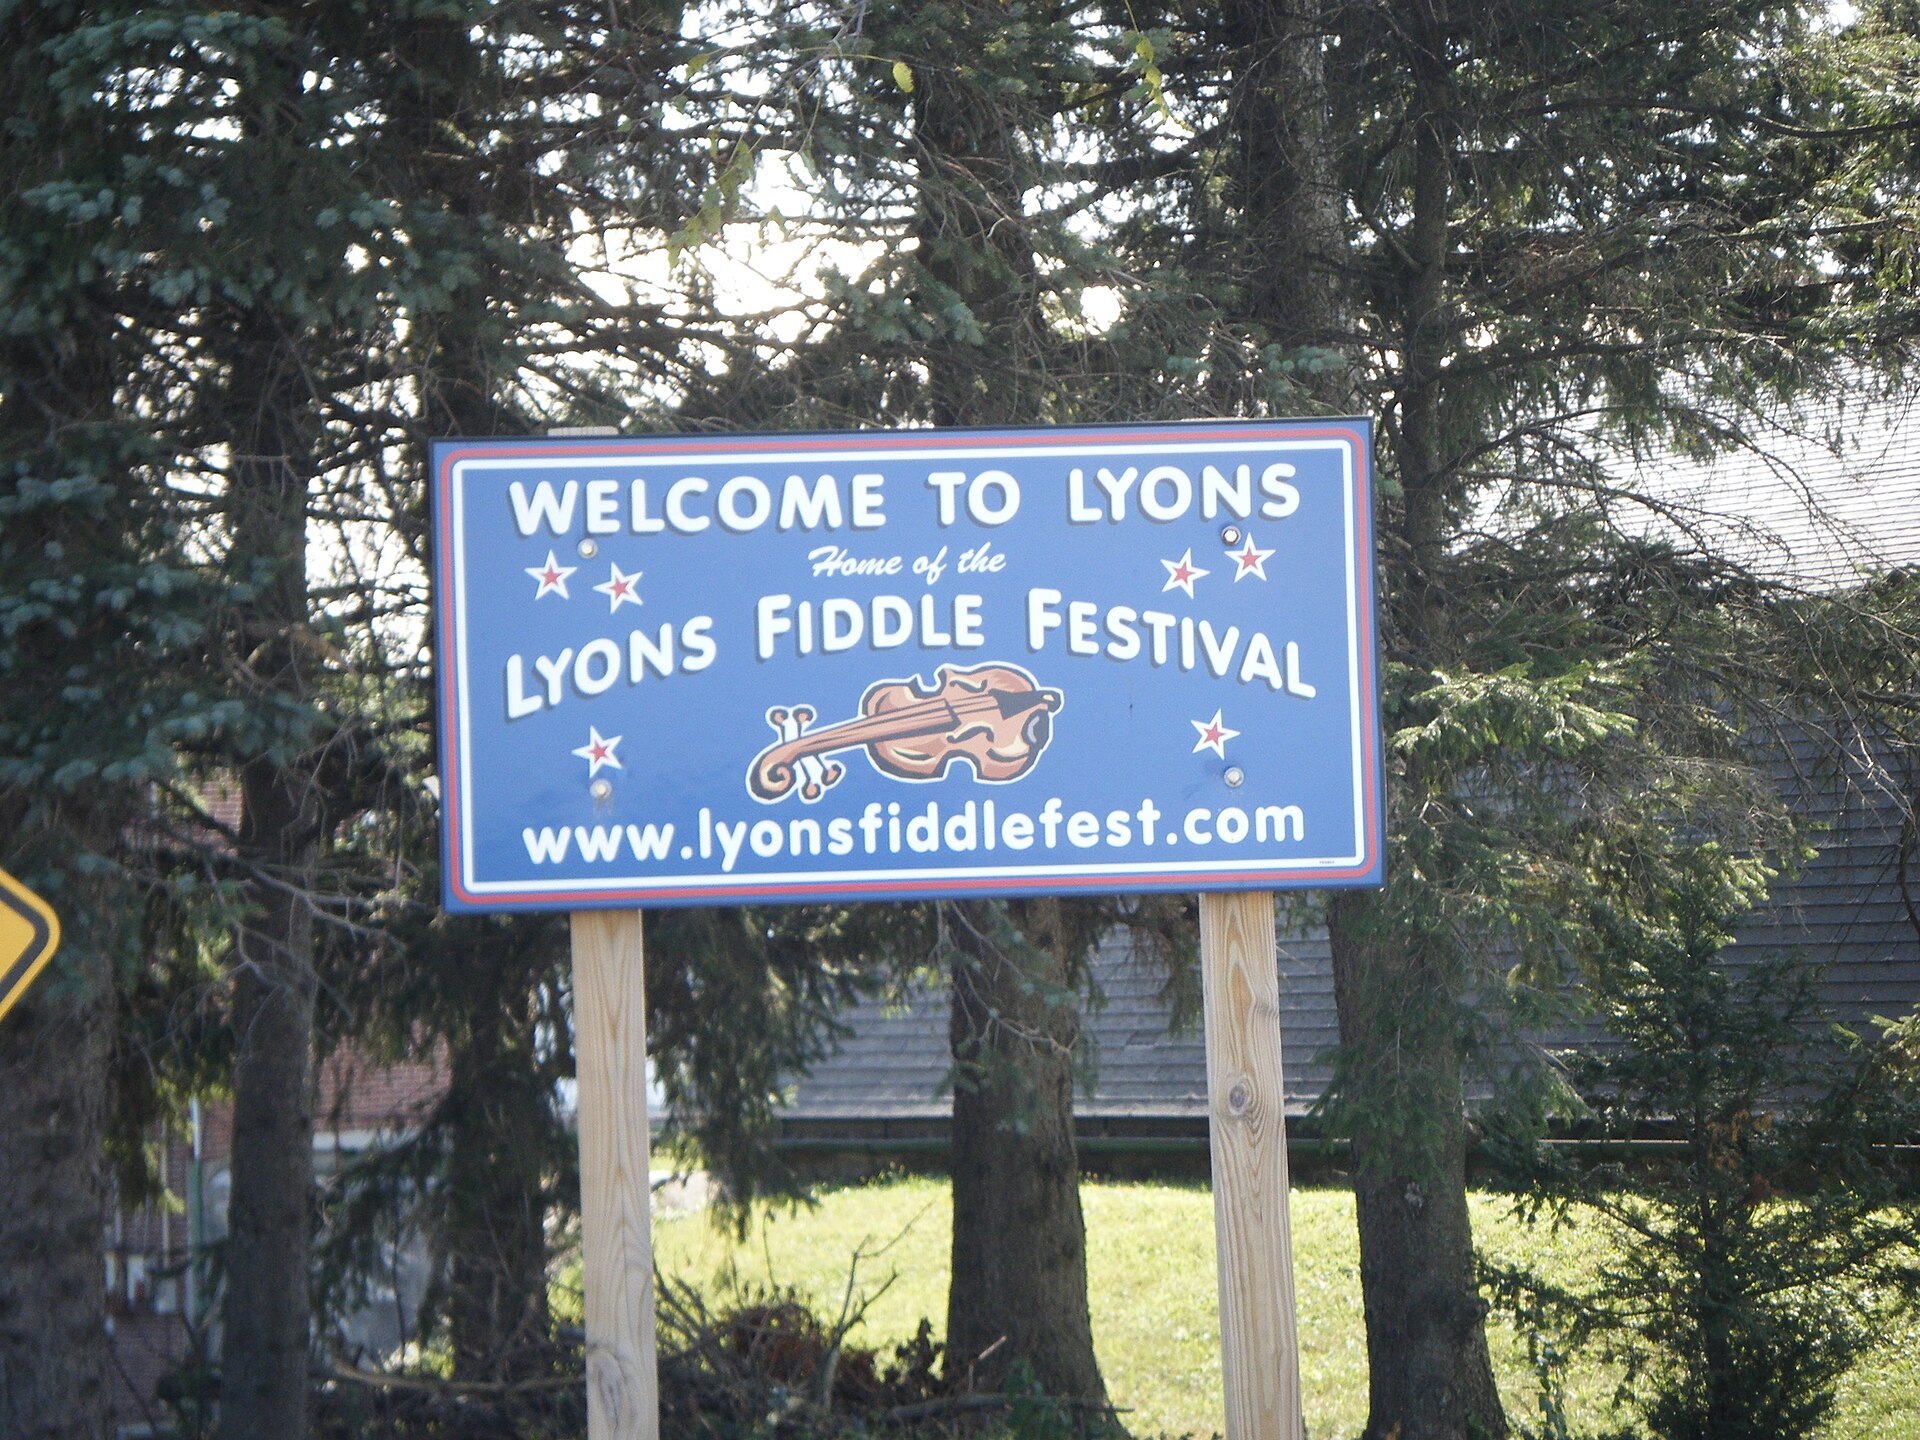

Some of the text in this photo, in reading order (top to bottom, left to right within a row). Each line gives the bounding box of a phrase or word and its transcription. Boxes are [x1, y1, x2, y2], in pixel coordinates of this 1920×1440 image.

[509, 462, 1301, 536] WELCOME TO LYONS
[808, 542, 1007, 586] Home of the
[506, 587, 1317, 718] LYONS FIDDLE FESTIVAL
[522, 799, 1305, 872] www.lyonsfiddlefest.com
